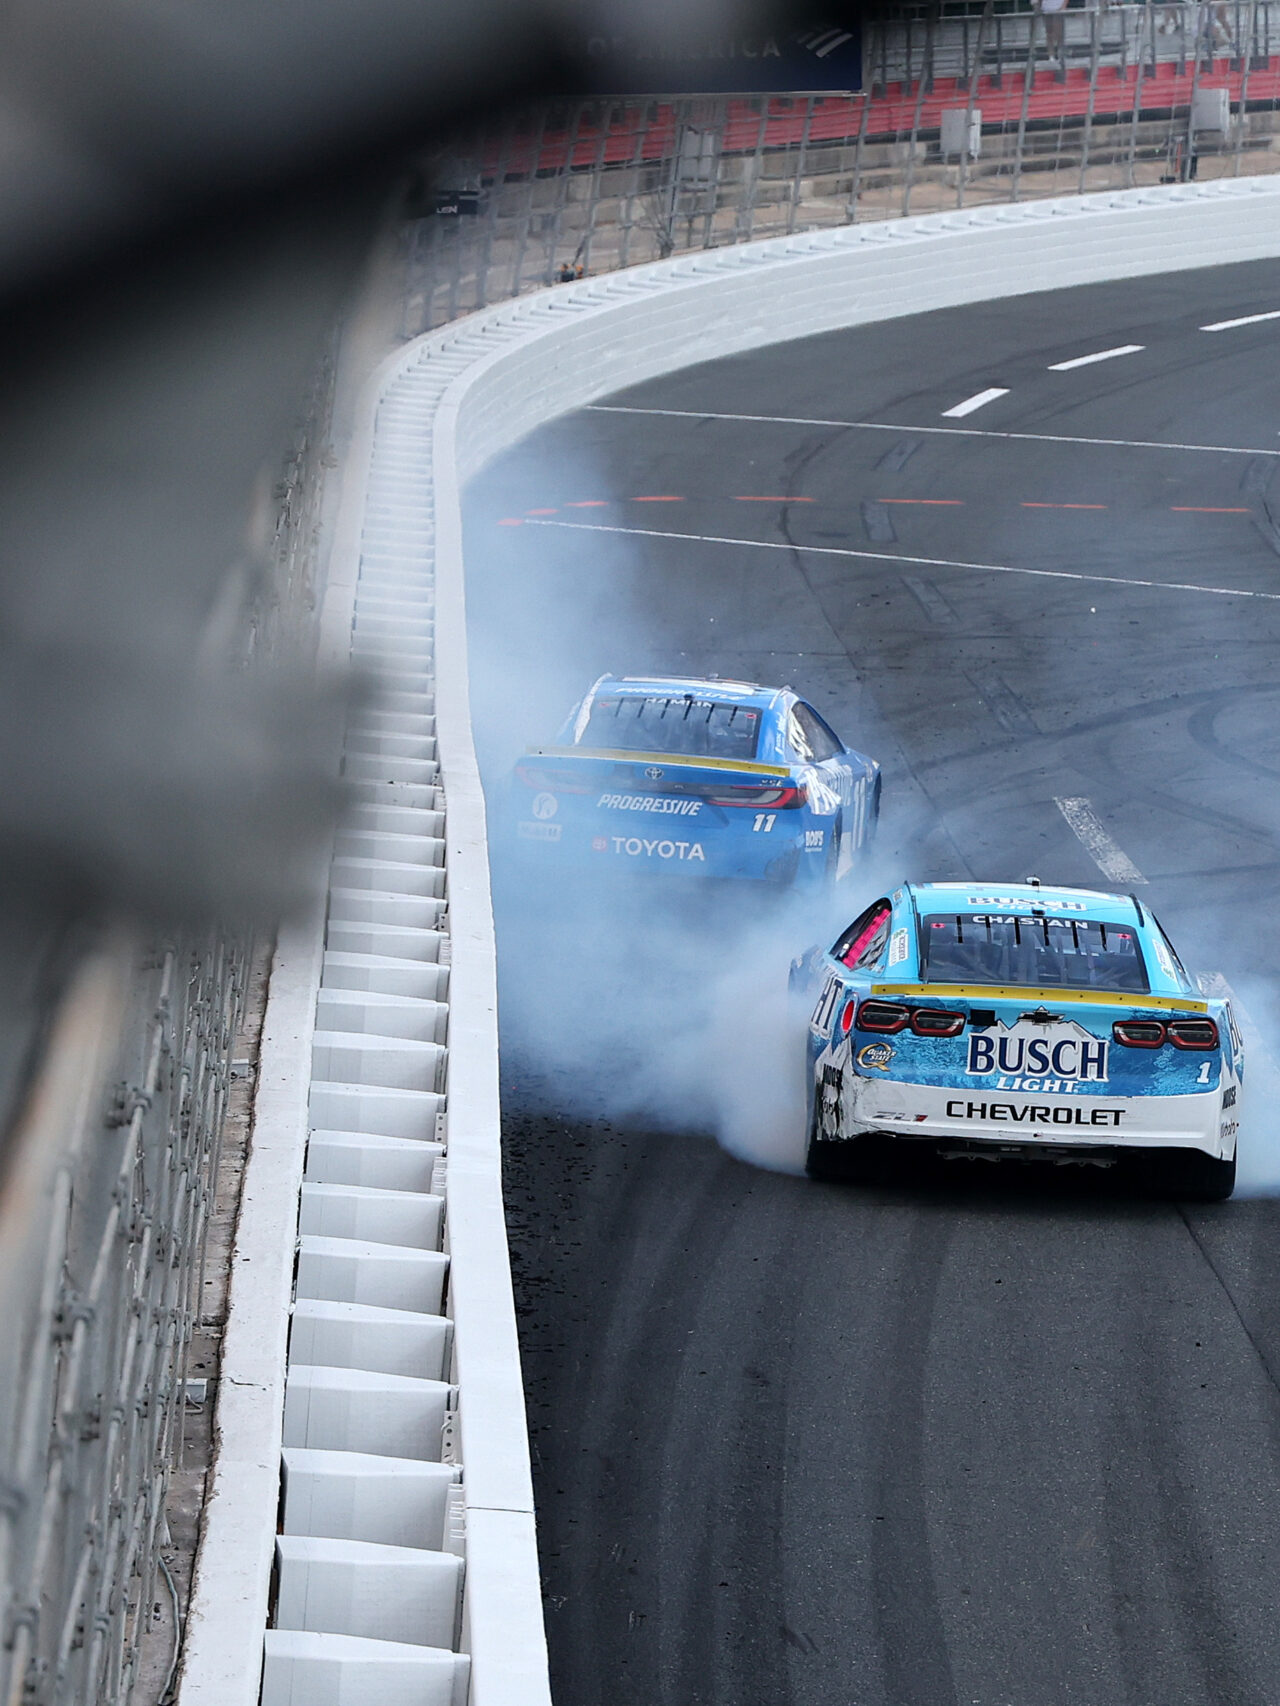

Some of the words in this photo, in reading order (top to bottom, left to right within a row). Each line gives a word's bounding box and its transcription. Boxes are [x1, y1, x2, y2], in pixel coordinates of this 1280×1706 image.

[645, 697, 713, 708] HAMLIN
[596, 793, 703, 816] PROGRESSIVE
[752, 813, 777, 832] 11
[612, 836, 705, 861] TOYOTA
[967, 896, 1087, 912] BUSCH
[972, 915, 1089, 929] CHASTAIN
[867, 1048, 897, 1058] QUAKER
[869, 1054, 891, 1062] STATE
[967, 1033, 1108, 1081] BUSCH
[1197, 1062, 1211, 1084] 1
[996, 1076, 1078, 1094] LIGHT
[872, 1111, 929, 1123] ZL1
[946, 1100, 1126, 1126] CHEVROLET
